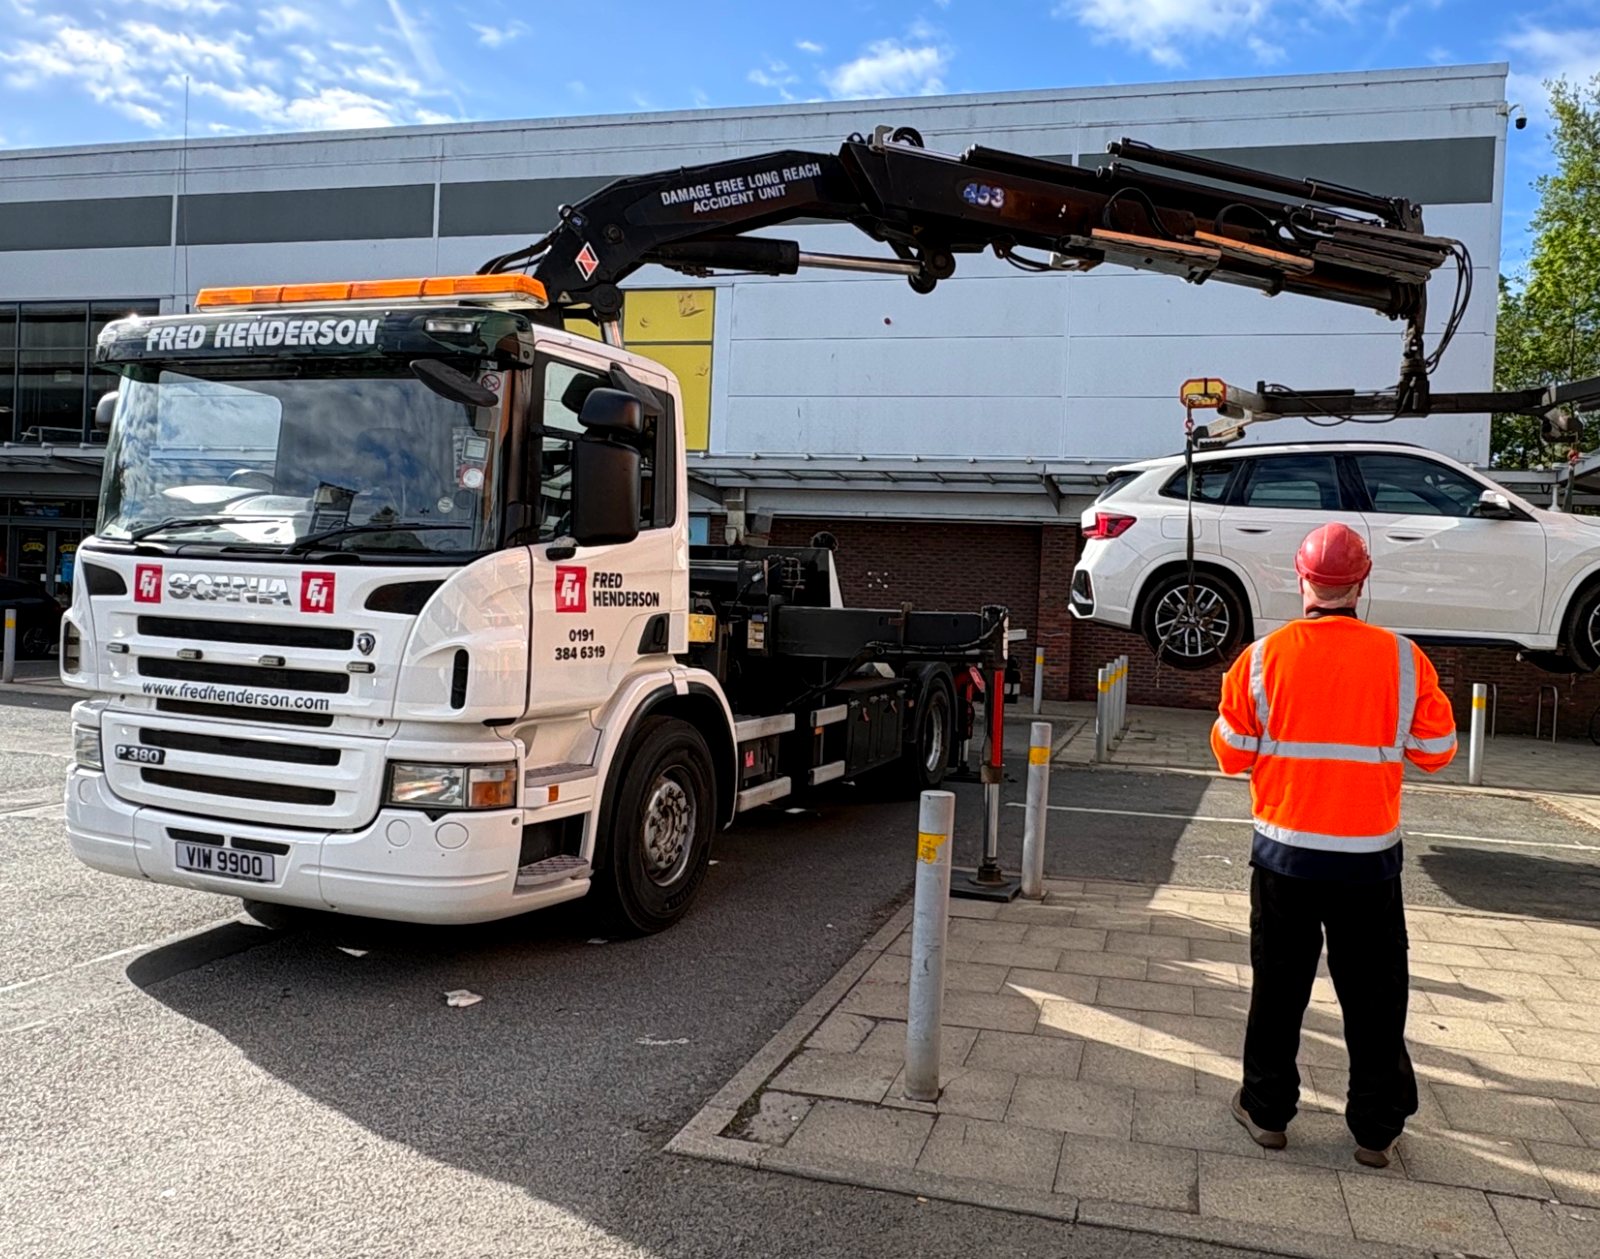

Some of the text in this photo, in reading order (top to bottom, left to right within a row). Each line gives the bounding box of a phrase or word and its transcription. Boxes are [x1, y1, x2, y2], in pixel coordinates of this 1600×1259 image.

[661, 162, 822, 206] DAMAGE FREE LONG REACH
[963, 183, 1004, 208] 453
[693, 184, 786, 214] ACCIDENT UNIT
[146, 319, 379, 352] FRED HENDERSON
[168, 573, 292, 606] SCANIA
[593, 572, 623, 588] FRED
[593, 591, 660, 607] HENDERSON
[569, 629, 594, 642] 0191
[555, 646, 605, 660] 384 6319
[142, 682, 329, 711] www.fredhenderson.com
[116, 745, 160, 764] P 380
[186, 846, 212, 869] VIW
[217, 854, 262, 877] 9900
